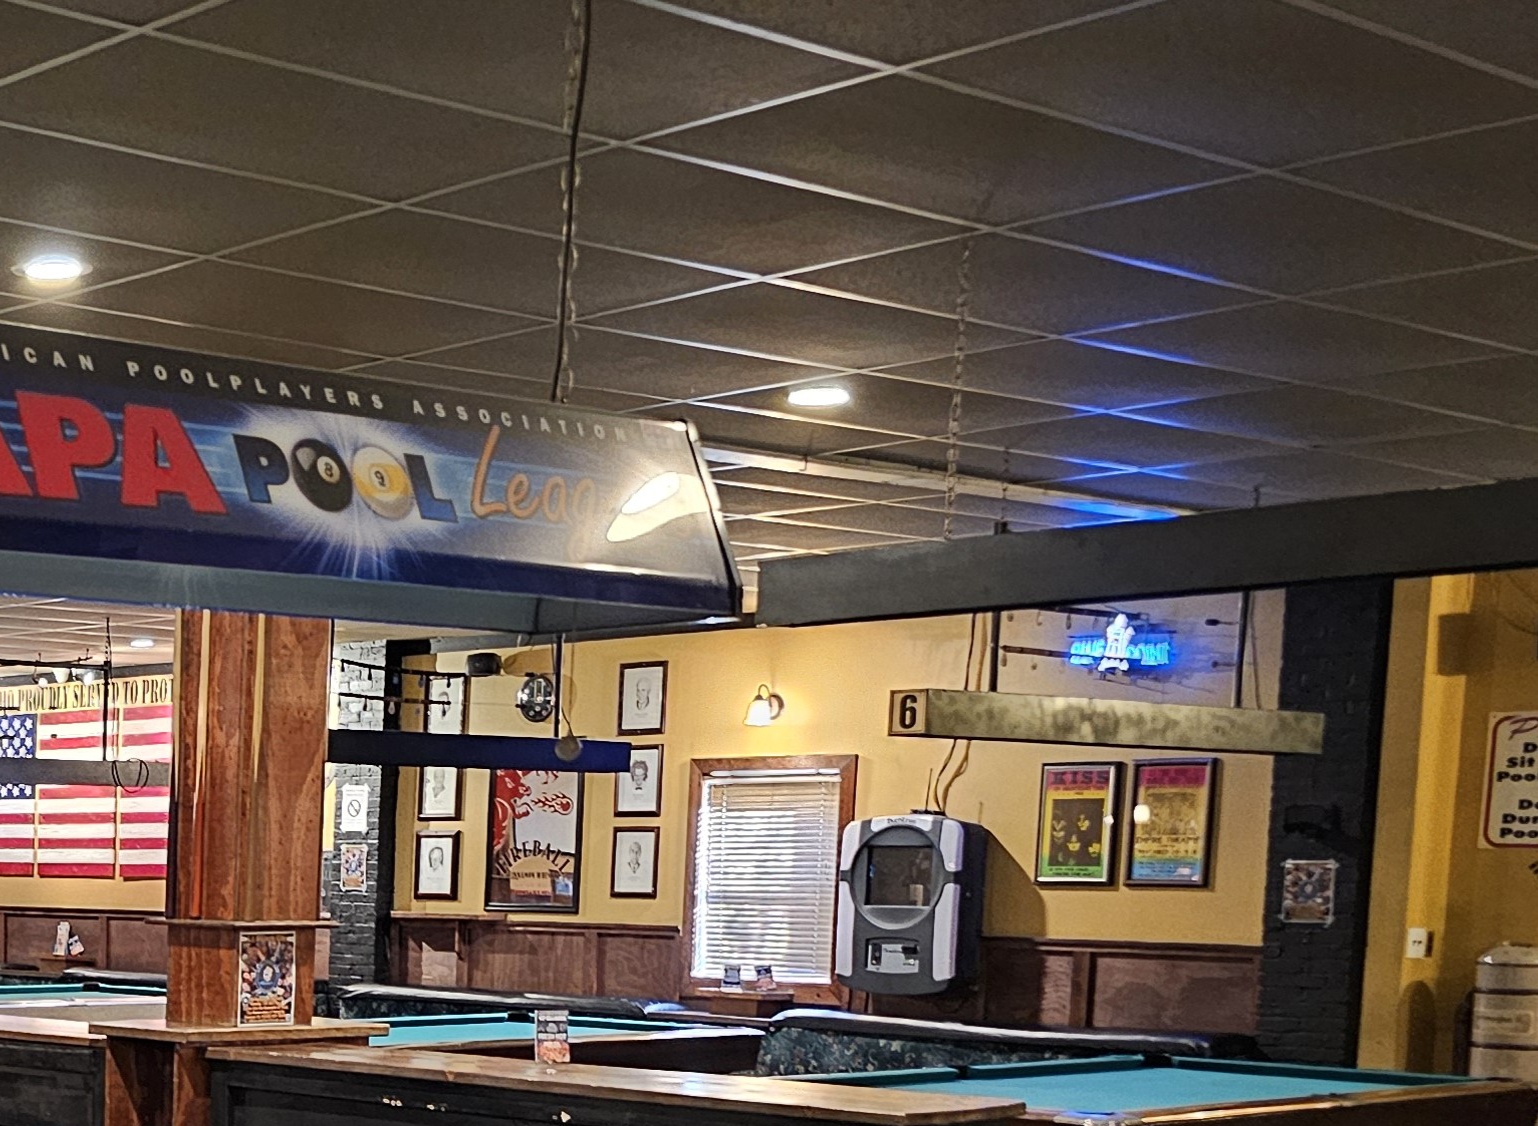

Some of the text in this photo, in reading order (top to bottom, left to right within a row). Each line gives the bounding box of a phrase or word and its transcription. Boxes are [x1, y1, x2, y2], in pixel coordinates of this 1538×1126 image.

[126, 360, 383, 410] POOLPLAYERS
[413, 400, 627, 442] ASSOCIATION
[233, 434, 458, 523] POOL
[19, 685, 70, 711] PROUDLY
[123, 680, 138, 704] TO
[899, 694, 918, 730] 6
[1051, 770, 1110, 785] KISS
[1496, 771, 1538, 783] Poo
[495, 840, 570, 876] FIREBALL
